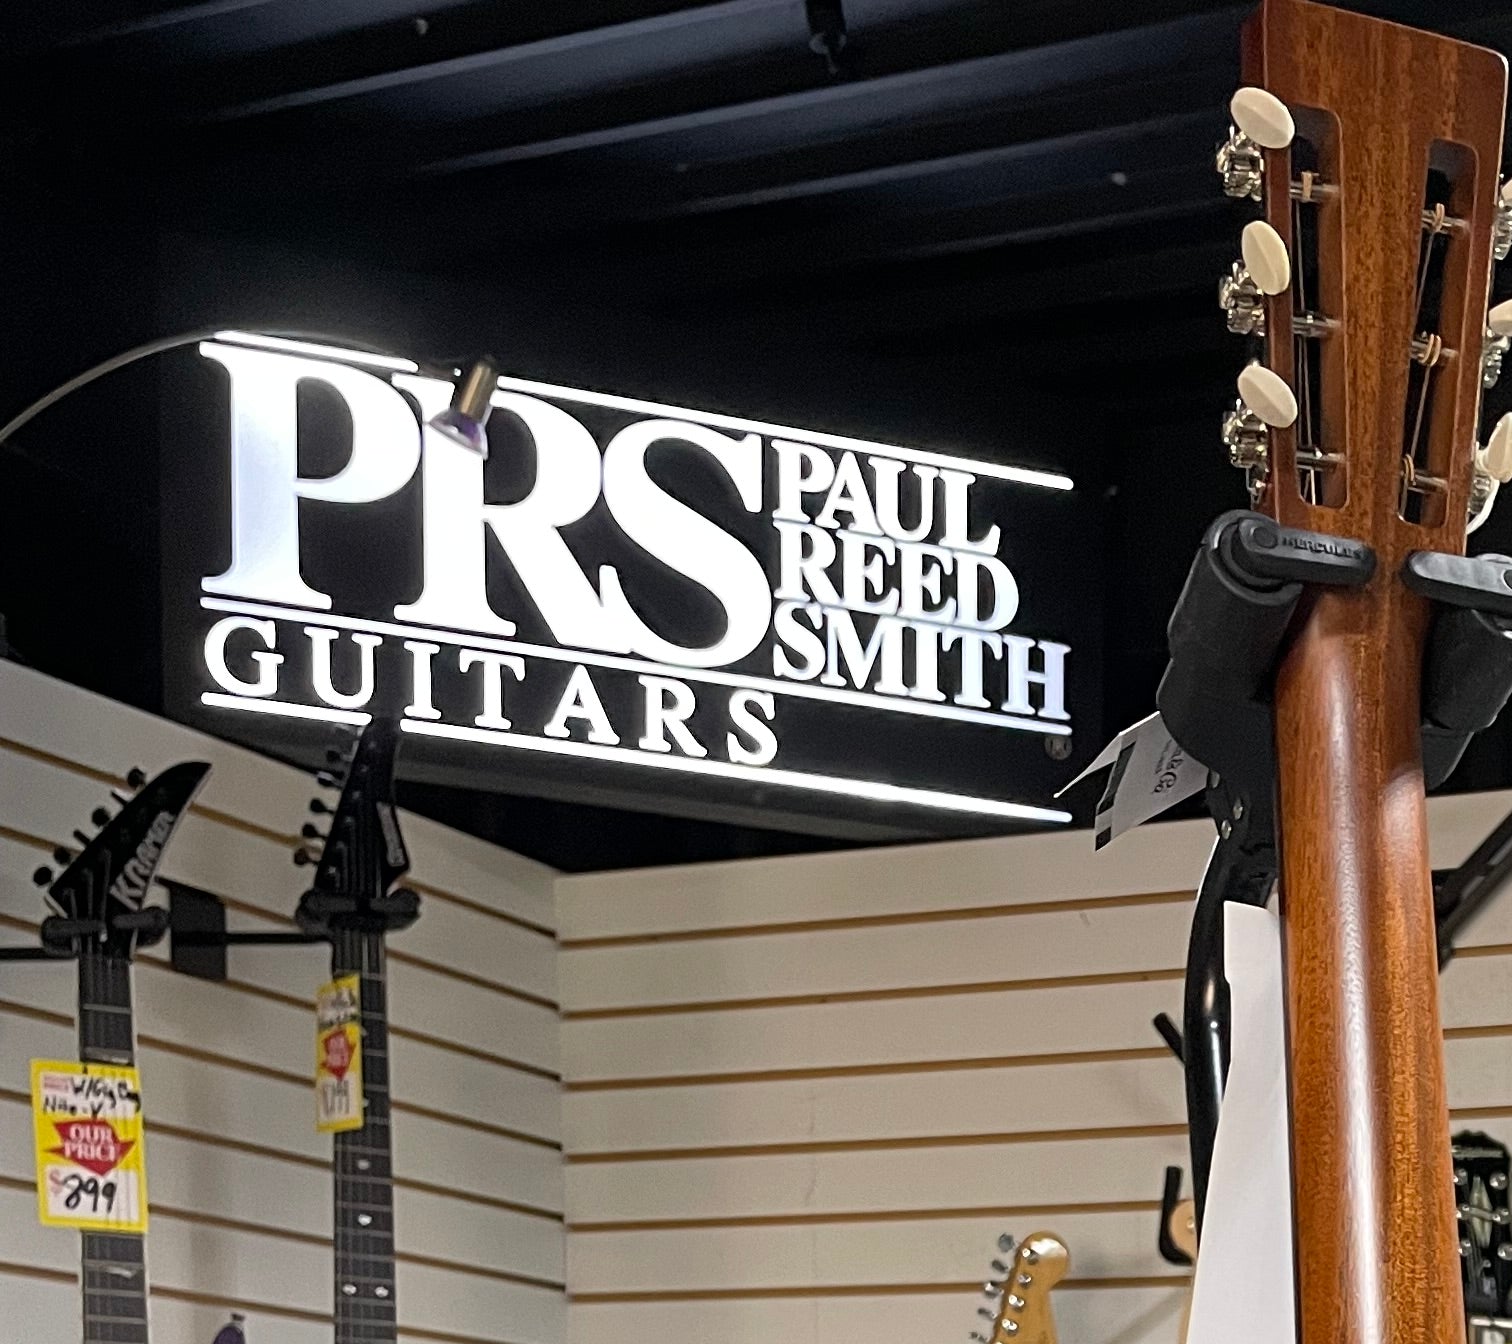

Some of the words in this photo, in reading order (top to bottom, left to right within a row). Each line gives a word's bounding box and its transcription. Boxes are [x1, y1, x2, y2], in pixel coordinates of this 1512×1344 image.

[199, 340, 773, 669] PRS
[771, 437, 1001, 557] PAUL
[772, 518, 1020, 633] REED
[202, 614, 779, 768] GUITARS
[772, 604, 1071, 722] SMITH
[64, 1141, 119, 1163] PRICE
[69, 1123, 114, 1145] OUR
